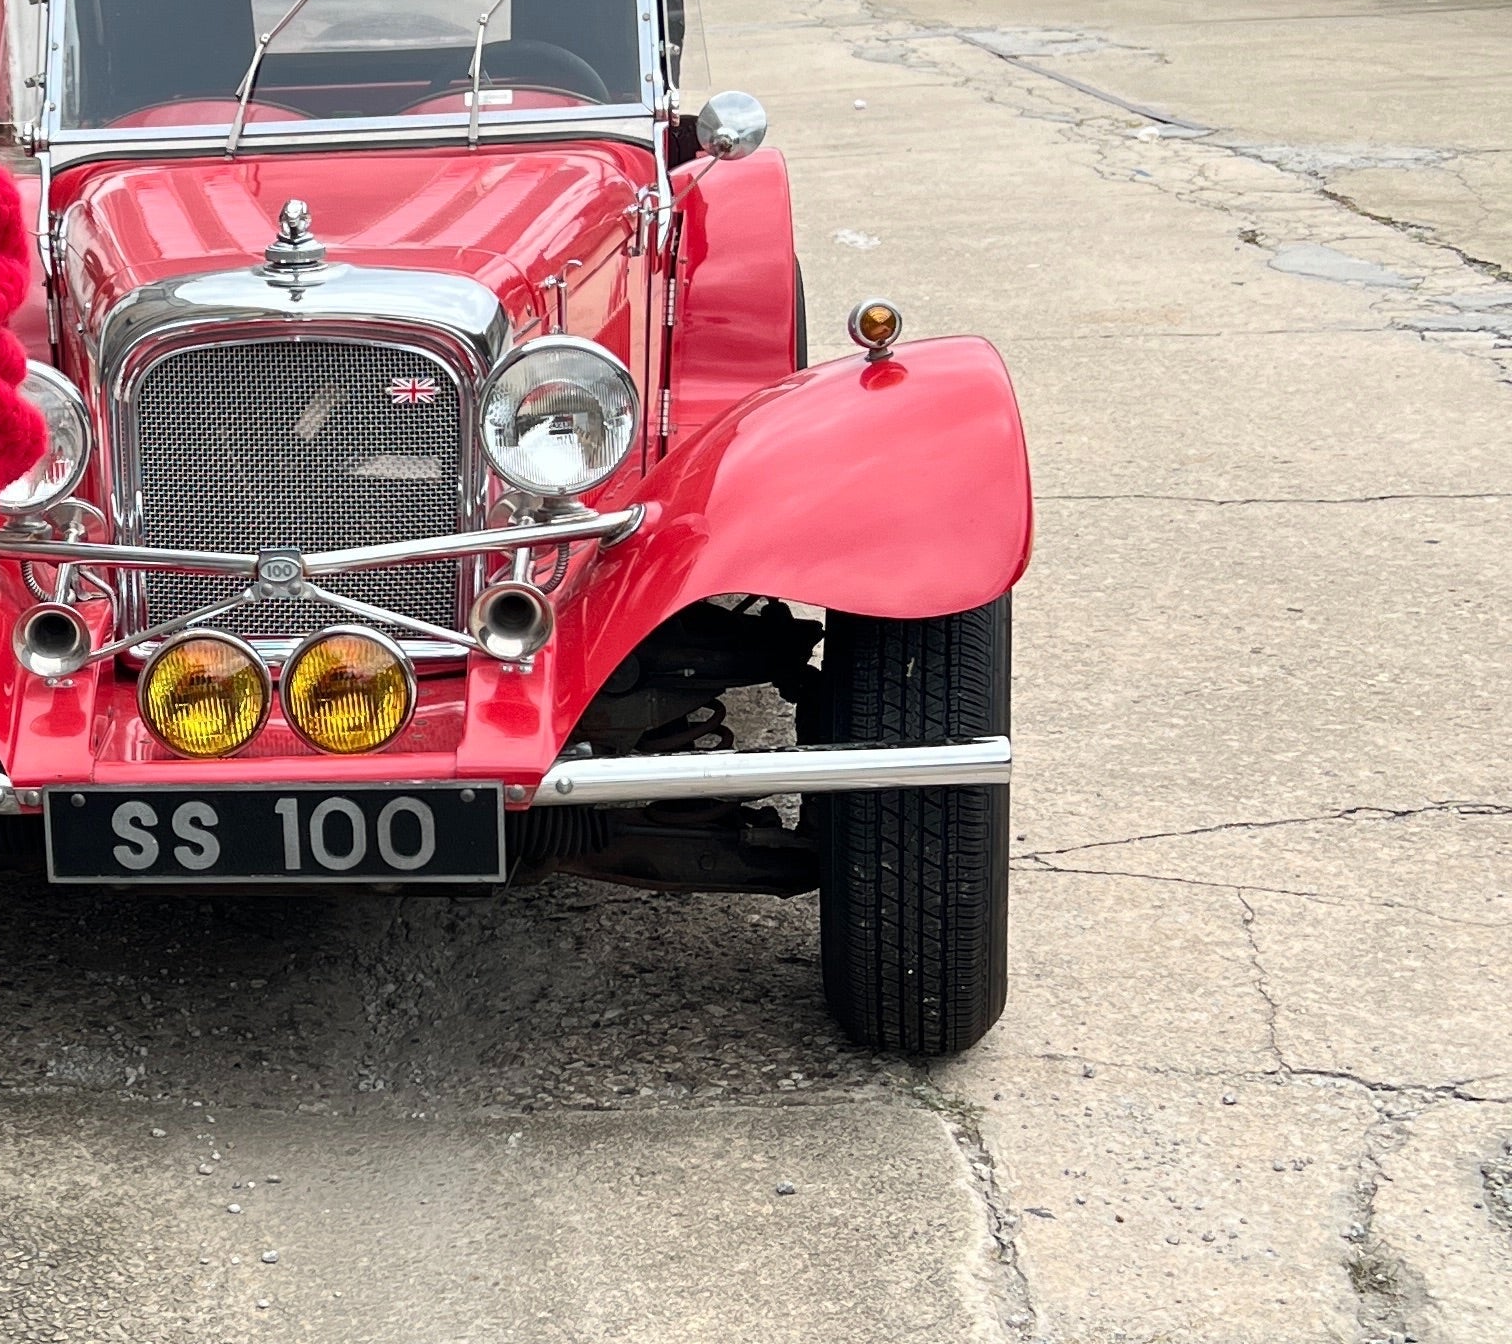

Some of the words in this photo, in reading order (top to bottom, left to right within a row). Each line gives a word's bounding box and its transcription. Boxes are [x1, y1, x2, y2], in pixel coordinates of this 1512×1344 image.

[267, 564, 292, 578] 100
[111, 800, 221, 870] SS
[274, 796, 436, 871] 100
